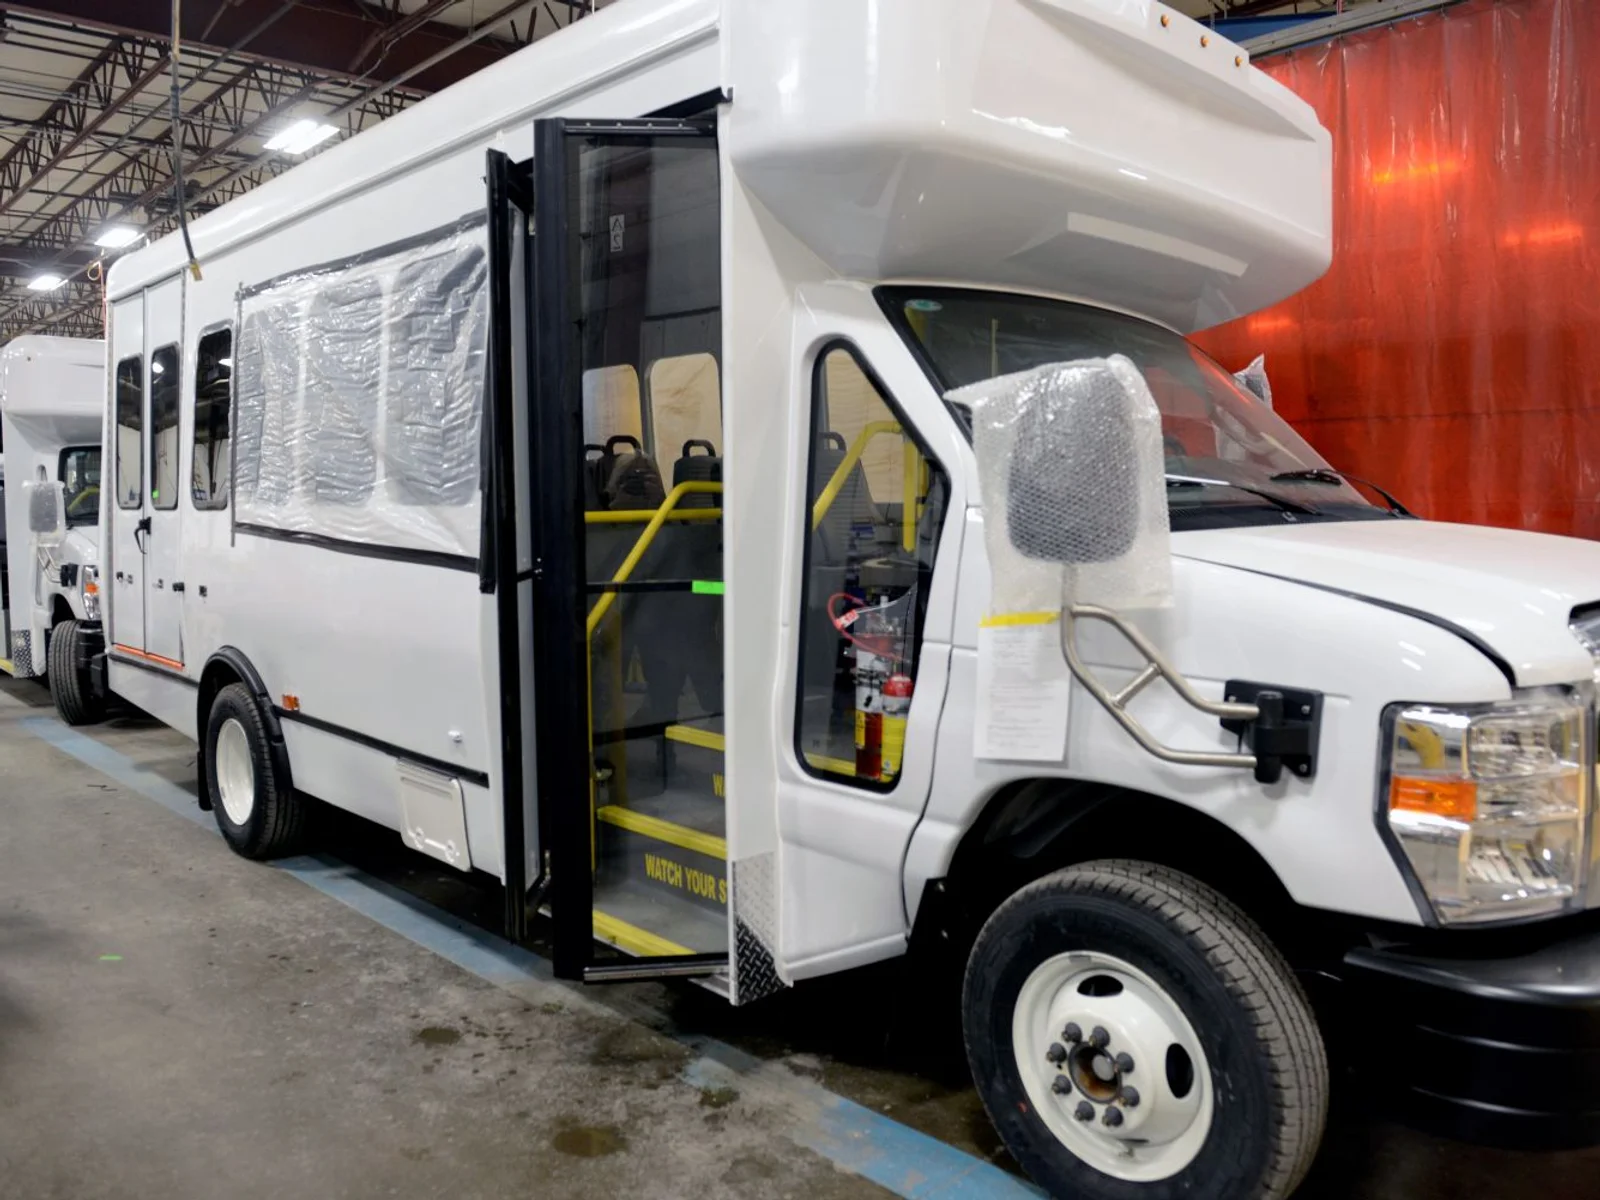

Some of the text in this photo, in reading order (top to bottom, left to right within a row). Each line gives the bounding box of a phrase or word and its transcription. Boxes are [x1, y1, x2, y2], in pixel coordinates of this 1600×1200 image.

[712, 772, 725, 798] W
[644, 853, 683, 889] WATCH
[684, 867, 717, 902] YOUR
